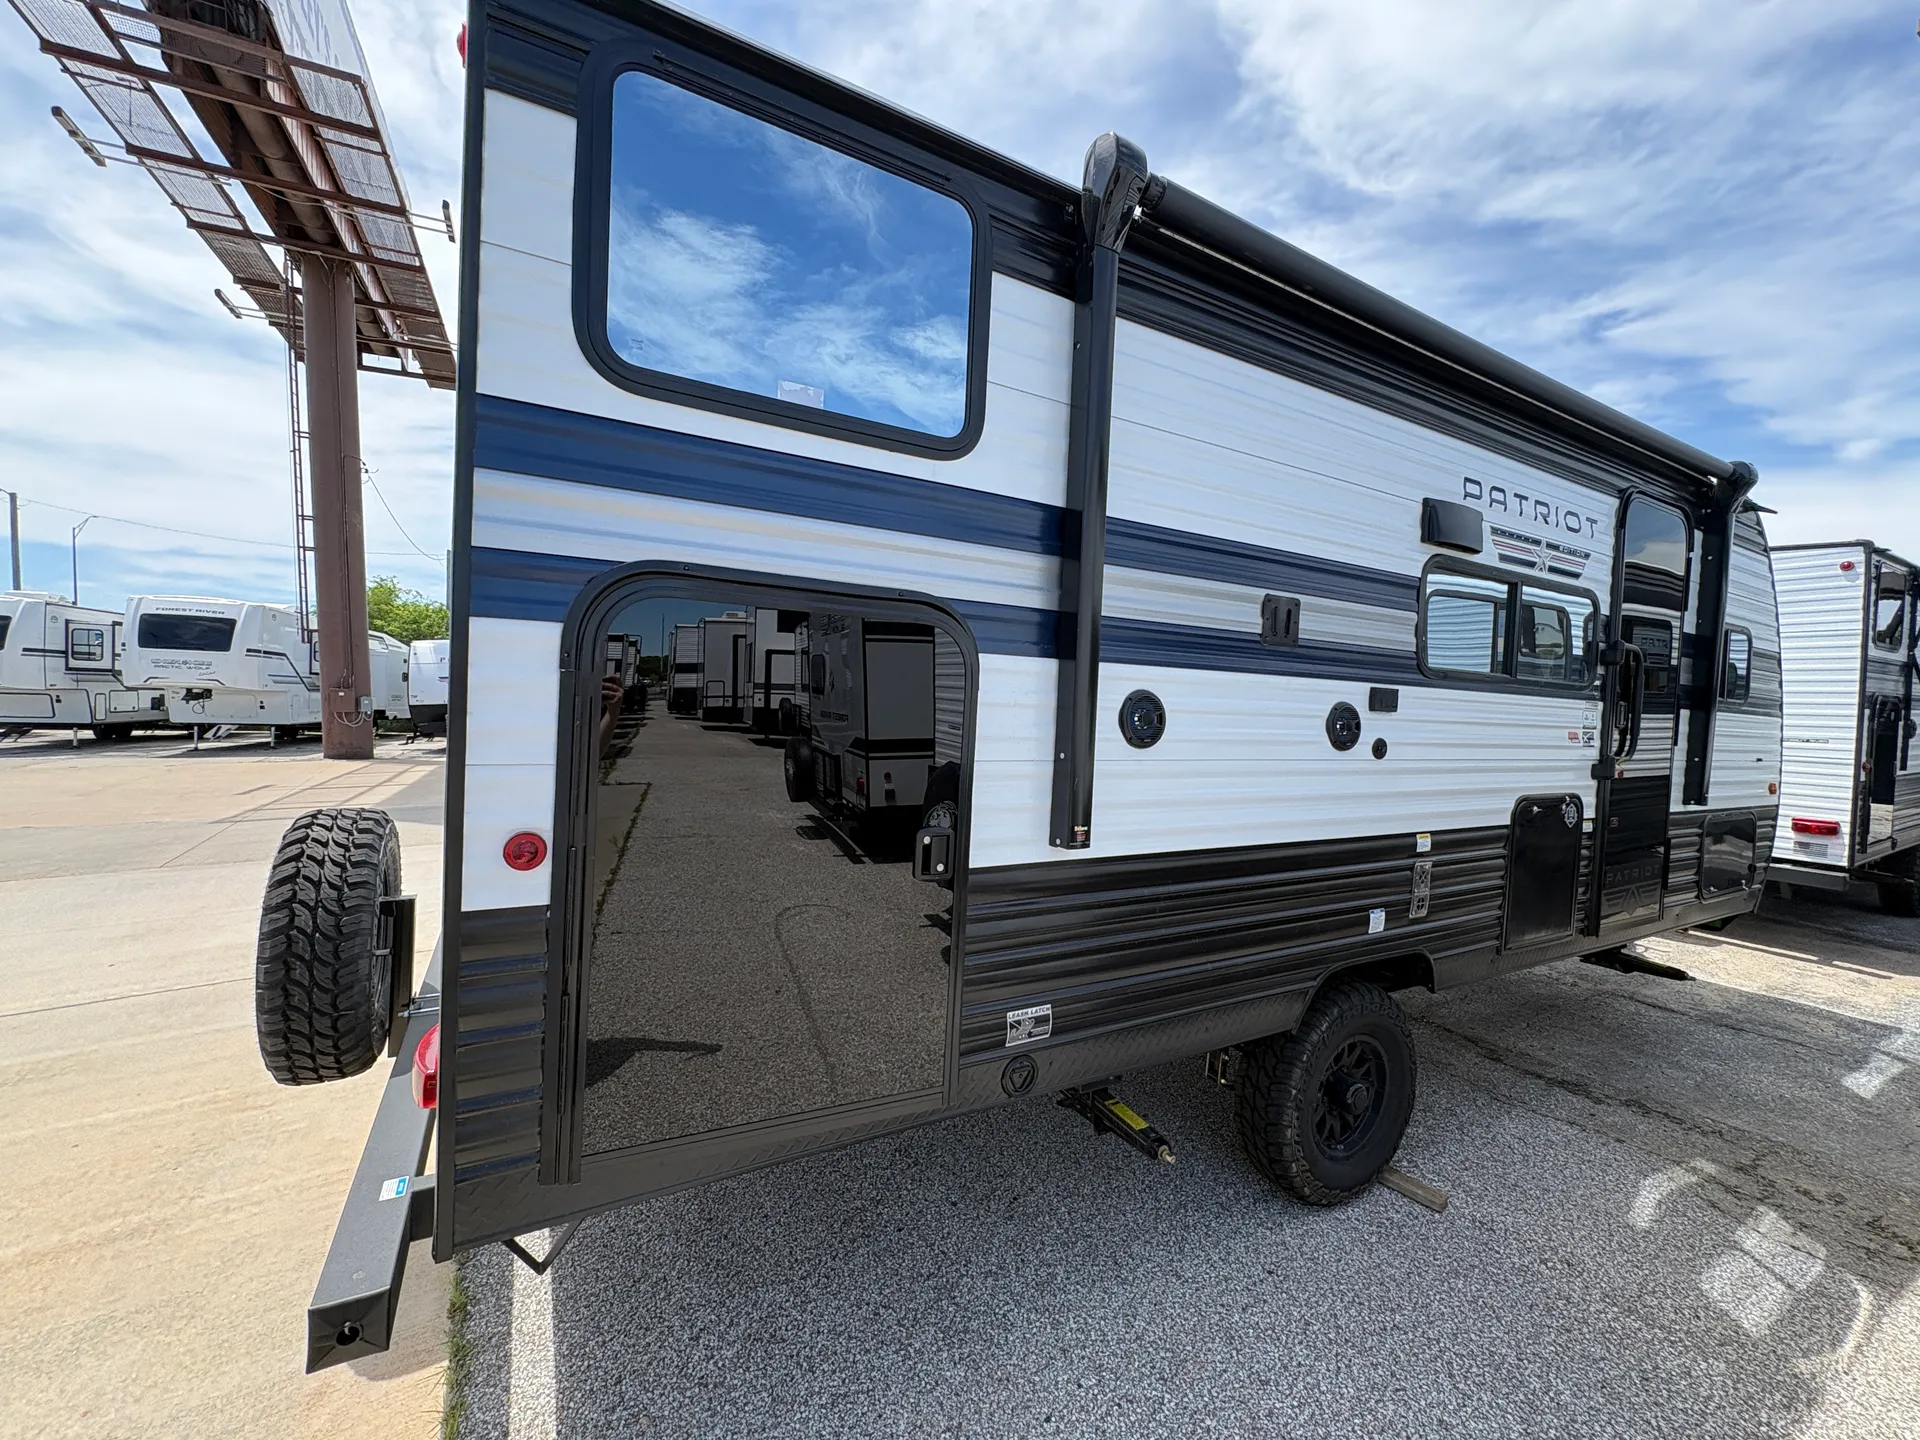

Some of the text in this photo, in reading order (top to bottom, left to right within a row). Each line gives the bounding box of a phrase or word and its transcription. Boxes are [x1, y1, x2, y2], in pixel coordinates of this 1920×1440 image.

[1463, 476, 1598, 538] PATRIOT
[1559, 545, 1586, 557] EDITION
[1606, 864, 1660, 884] PATRIOT
[1008, 1007, 1050, 1019] LEASH LATCH
